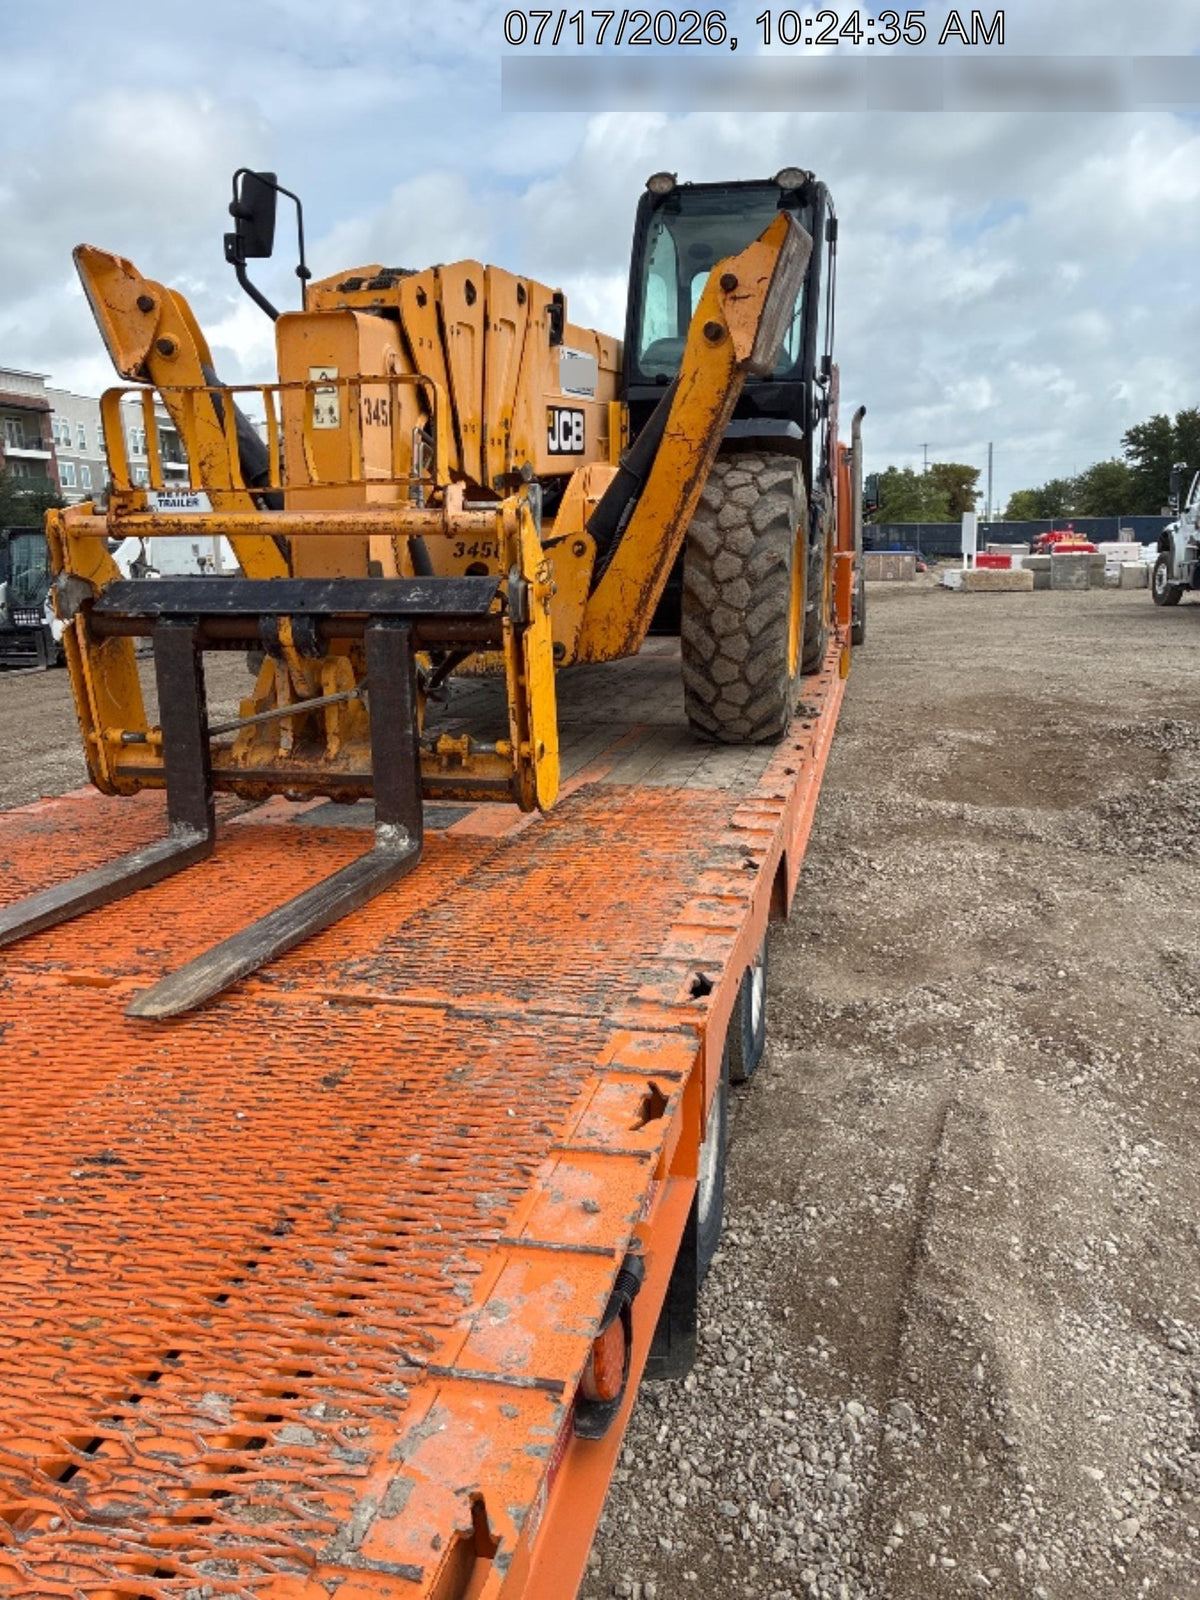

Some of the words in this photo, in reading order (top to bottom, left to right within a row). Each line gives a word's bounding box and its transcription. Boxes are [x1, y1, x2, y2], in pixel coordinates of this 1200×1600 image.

[363, 397, 402, 427] 345
[548, 409, 584, 451] JCB
[157, 498, 199, 507] TRAILER
